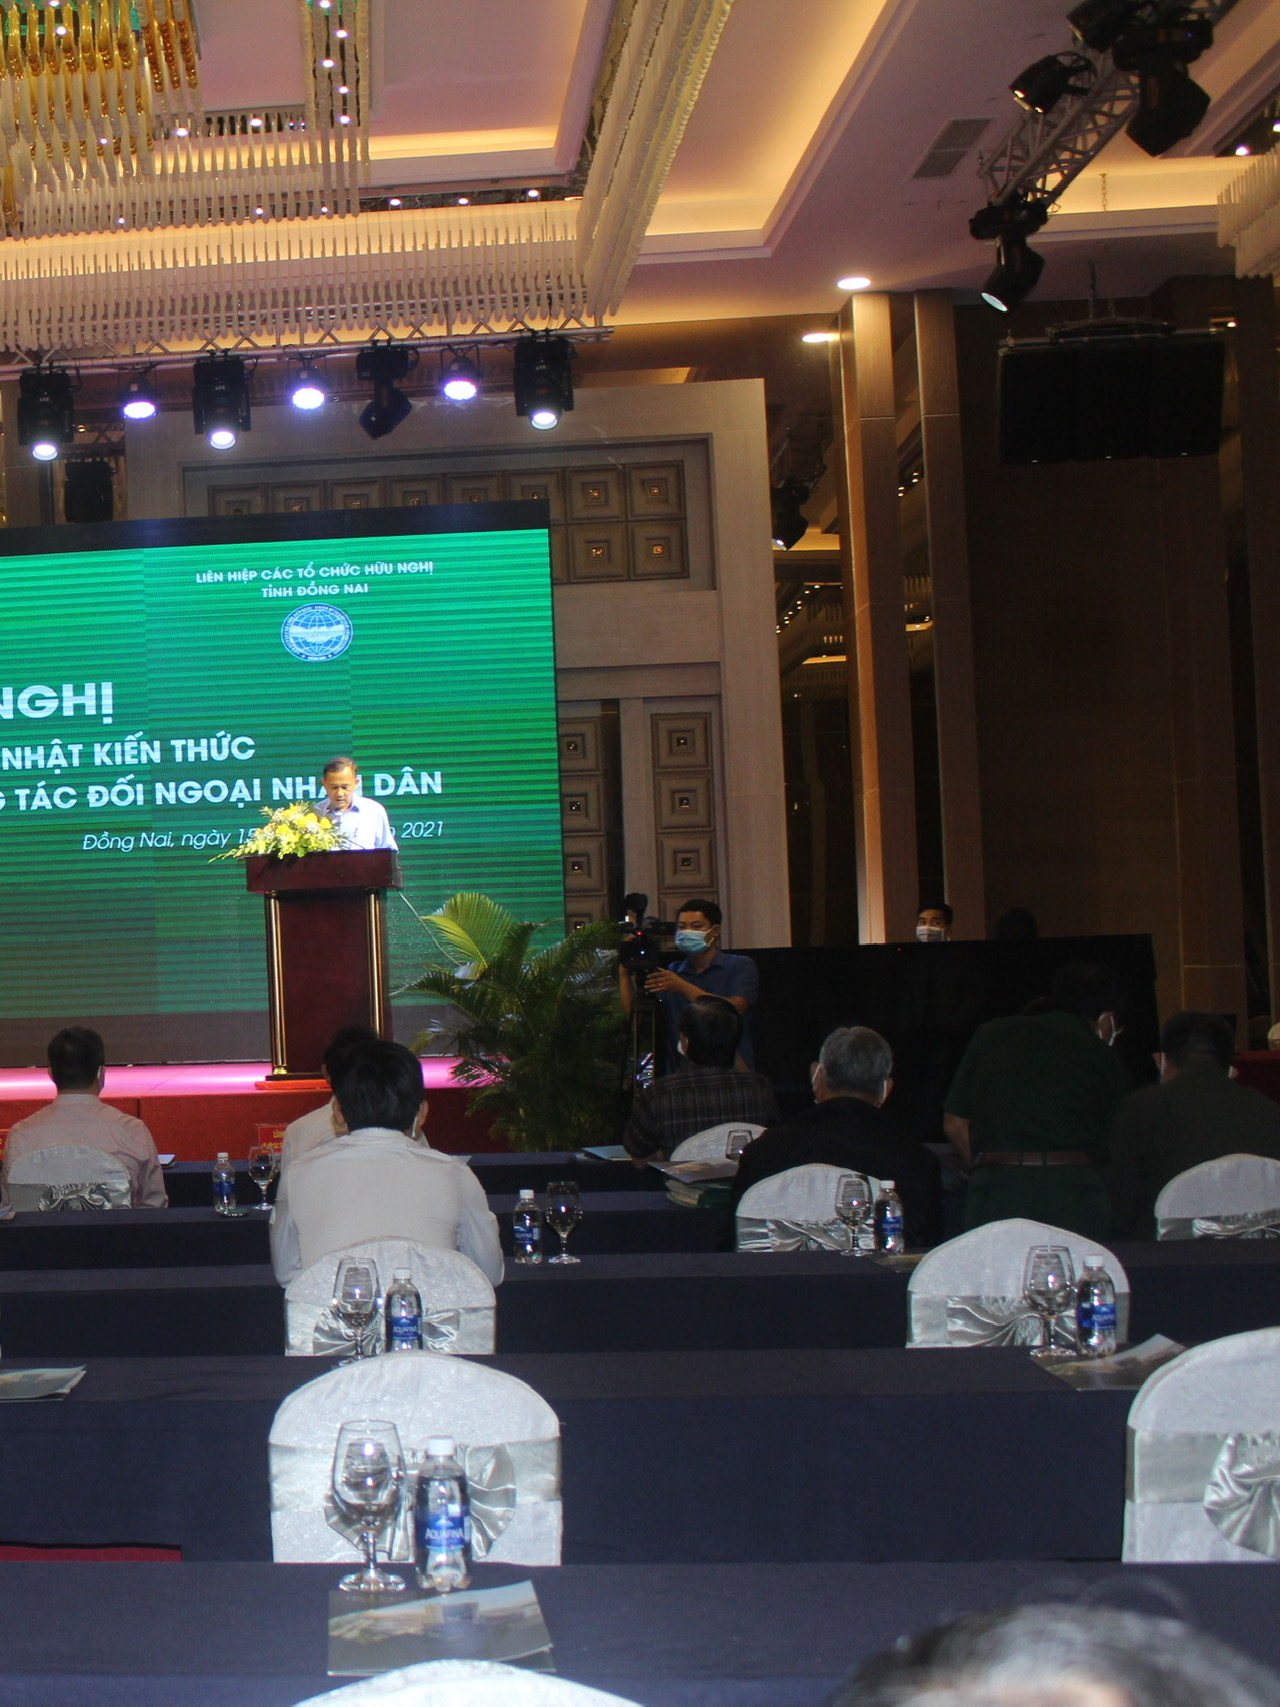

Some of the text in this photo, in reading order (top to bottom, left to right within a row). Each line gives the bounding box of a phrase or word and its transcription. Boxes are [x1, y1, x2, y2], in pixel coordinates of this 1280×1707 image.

[196, 569, 223, 583] LIÊN
[228, 568, 257, 584] HIỆP
[261, 566, 293, 580] CÁC
[319, 562, 361, 577] CHỨC
[365, 561, 393, 575] HỮU
[398, 561, 433, 575] NGHỊ
[261, 580, 368, 597] TỈNH ĐỒNG NAI
[2, 738, 83, 774] NHẬT
[94, 731, 161, 766] KIẾN
[171, 730, 255, 762] THỨC
[15, 781, 77, 810] TÁC
[87, 774, 143, 808] ĐỐI
[155, 778, 261, 809] NGOẠI
[272, 775, 363, 800] NH
[374, 766, 442, 796] DÂN
[83, 831, 134, 852] Đồng
[140, 831, 175, 847] Nai,
[181, 830, 231, 850] ngày
[401, 821, 443, 839] 2021
[425, 1527, 465, 1541] AQUAFINA
